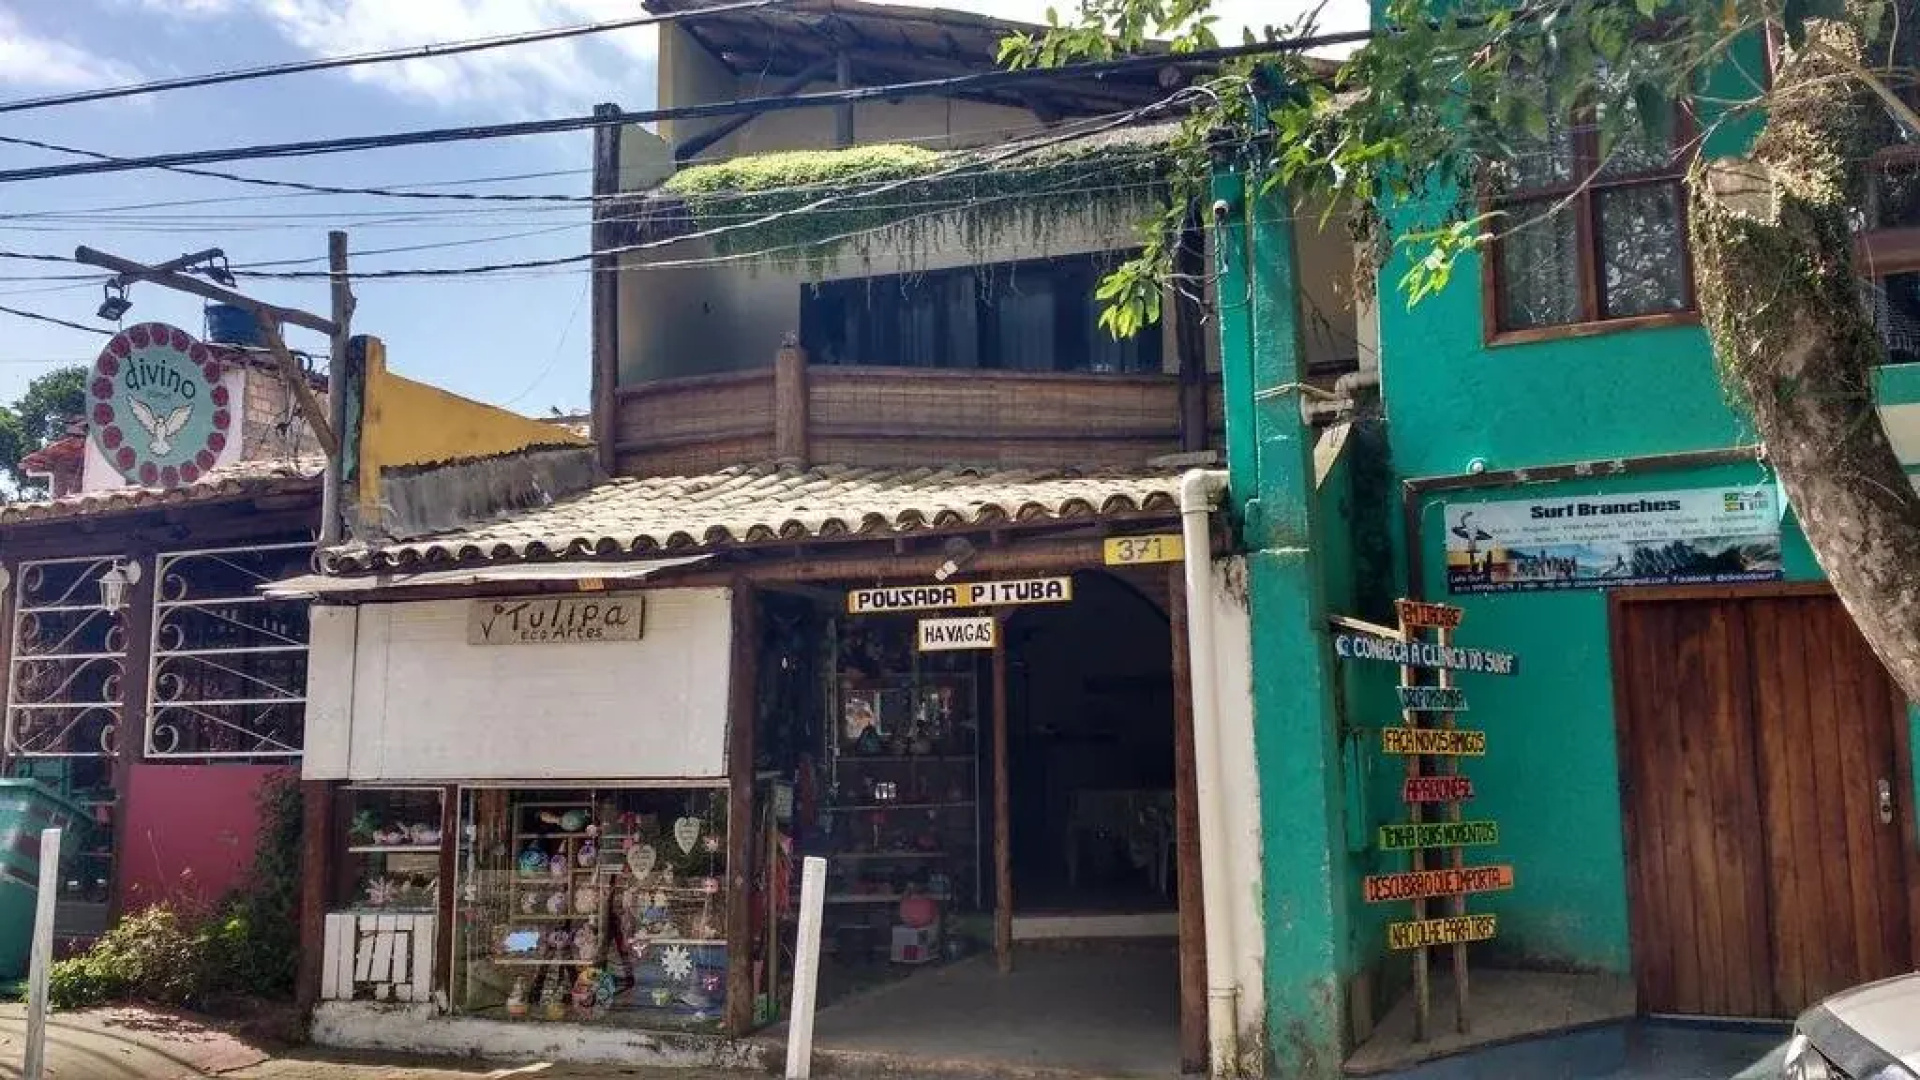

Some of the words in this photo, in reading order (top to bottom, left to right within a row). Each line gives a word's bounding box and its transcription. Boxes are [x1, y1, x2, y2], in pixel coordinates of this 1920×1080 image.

[125, 355, 196, 399] divino
[1531, 504, 1574, 519] Surf
[1577, 499, 1681, 516] Branches
[1117, 538, 1162, 560] 371
[858, 588, 956, 609] POUSADA
[971, 580, 1063, 602] PITUBA
[552, 624, 603, 639] Artes
[946, 622, 991, 642] VAGAS
[1484, 650, 1514, 674] SURF
[1415, 732, 1448, 751] NOVOS
[1443, 822, 1496, 844] MOMENTOS
